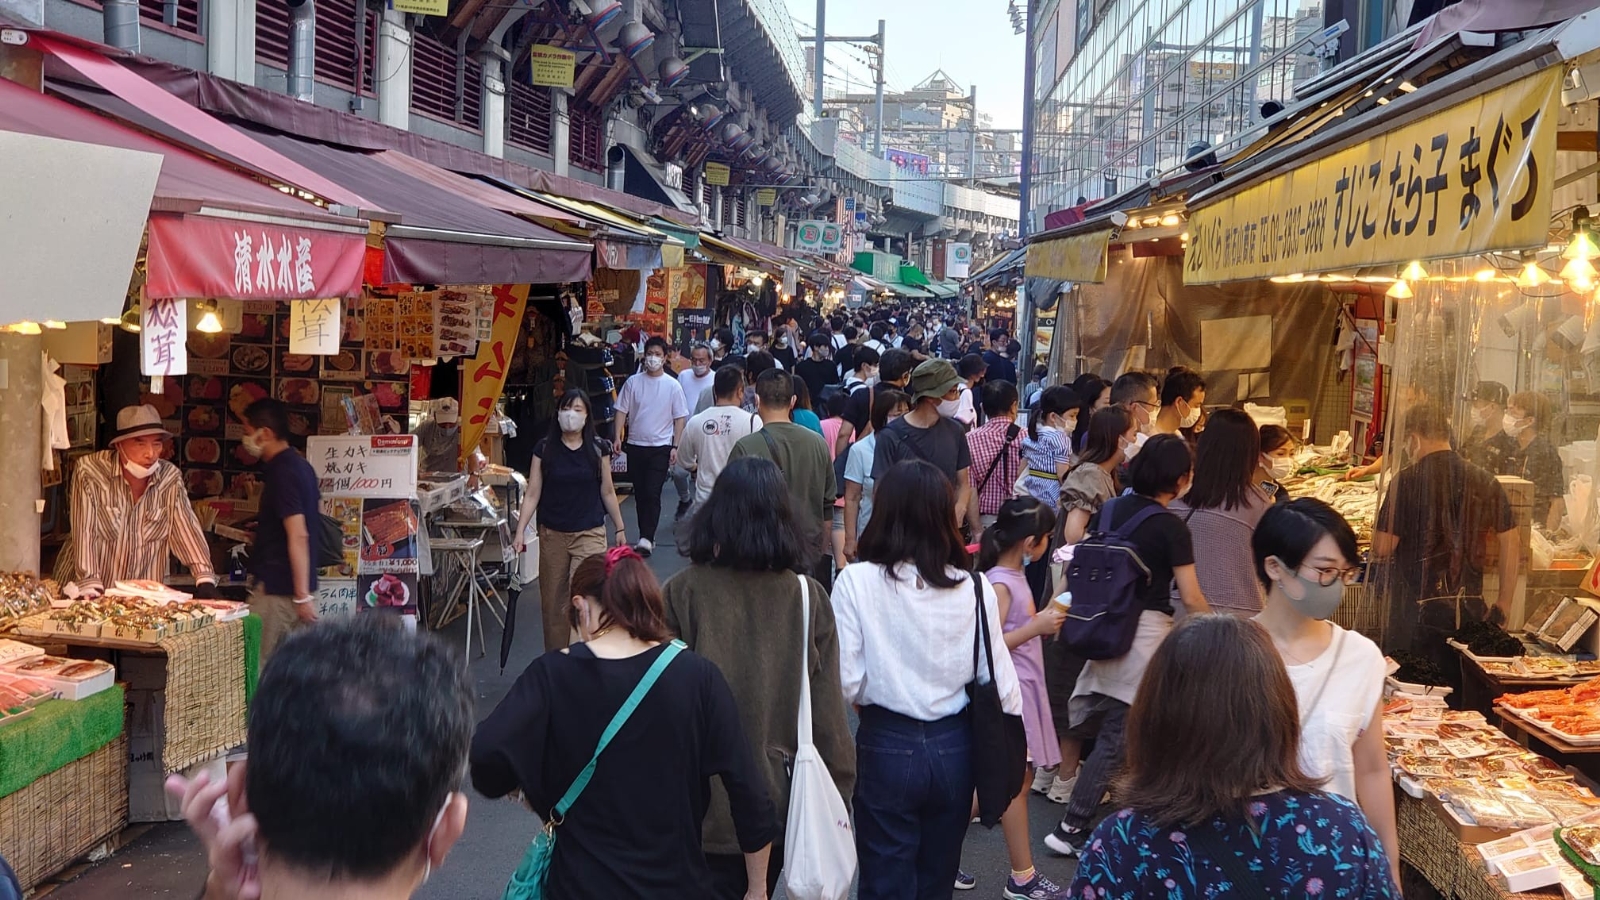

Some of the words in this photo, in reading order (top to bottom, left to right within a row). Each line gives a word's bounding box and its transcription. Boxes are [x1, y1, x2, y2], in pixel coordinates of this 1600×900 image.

[1333, 160, 1381, 249] すじこ
[1383, 131, 1449, 238] たら子
[1458, 108, 1540, 231] まぐろ
[234, 229, 315, 294] 清水水産
[325, 445, 368, 460] 生カキ
